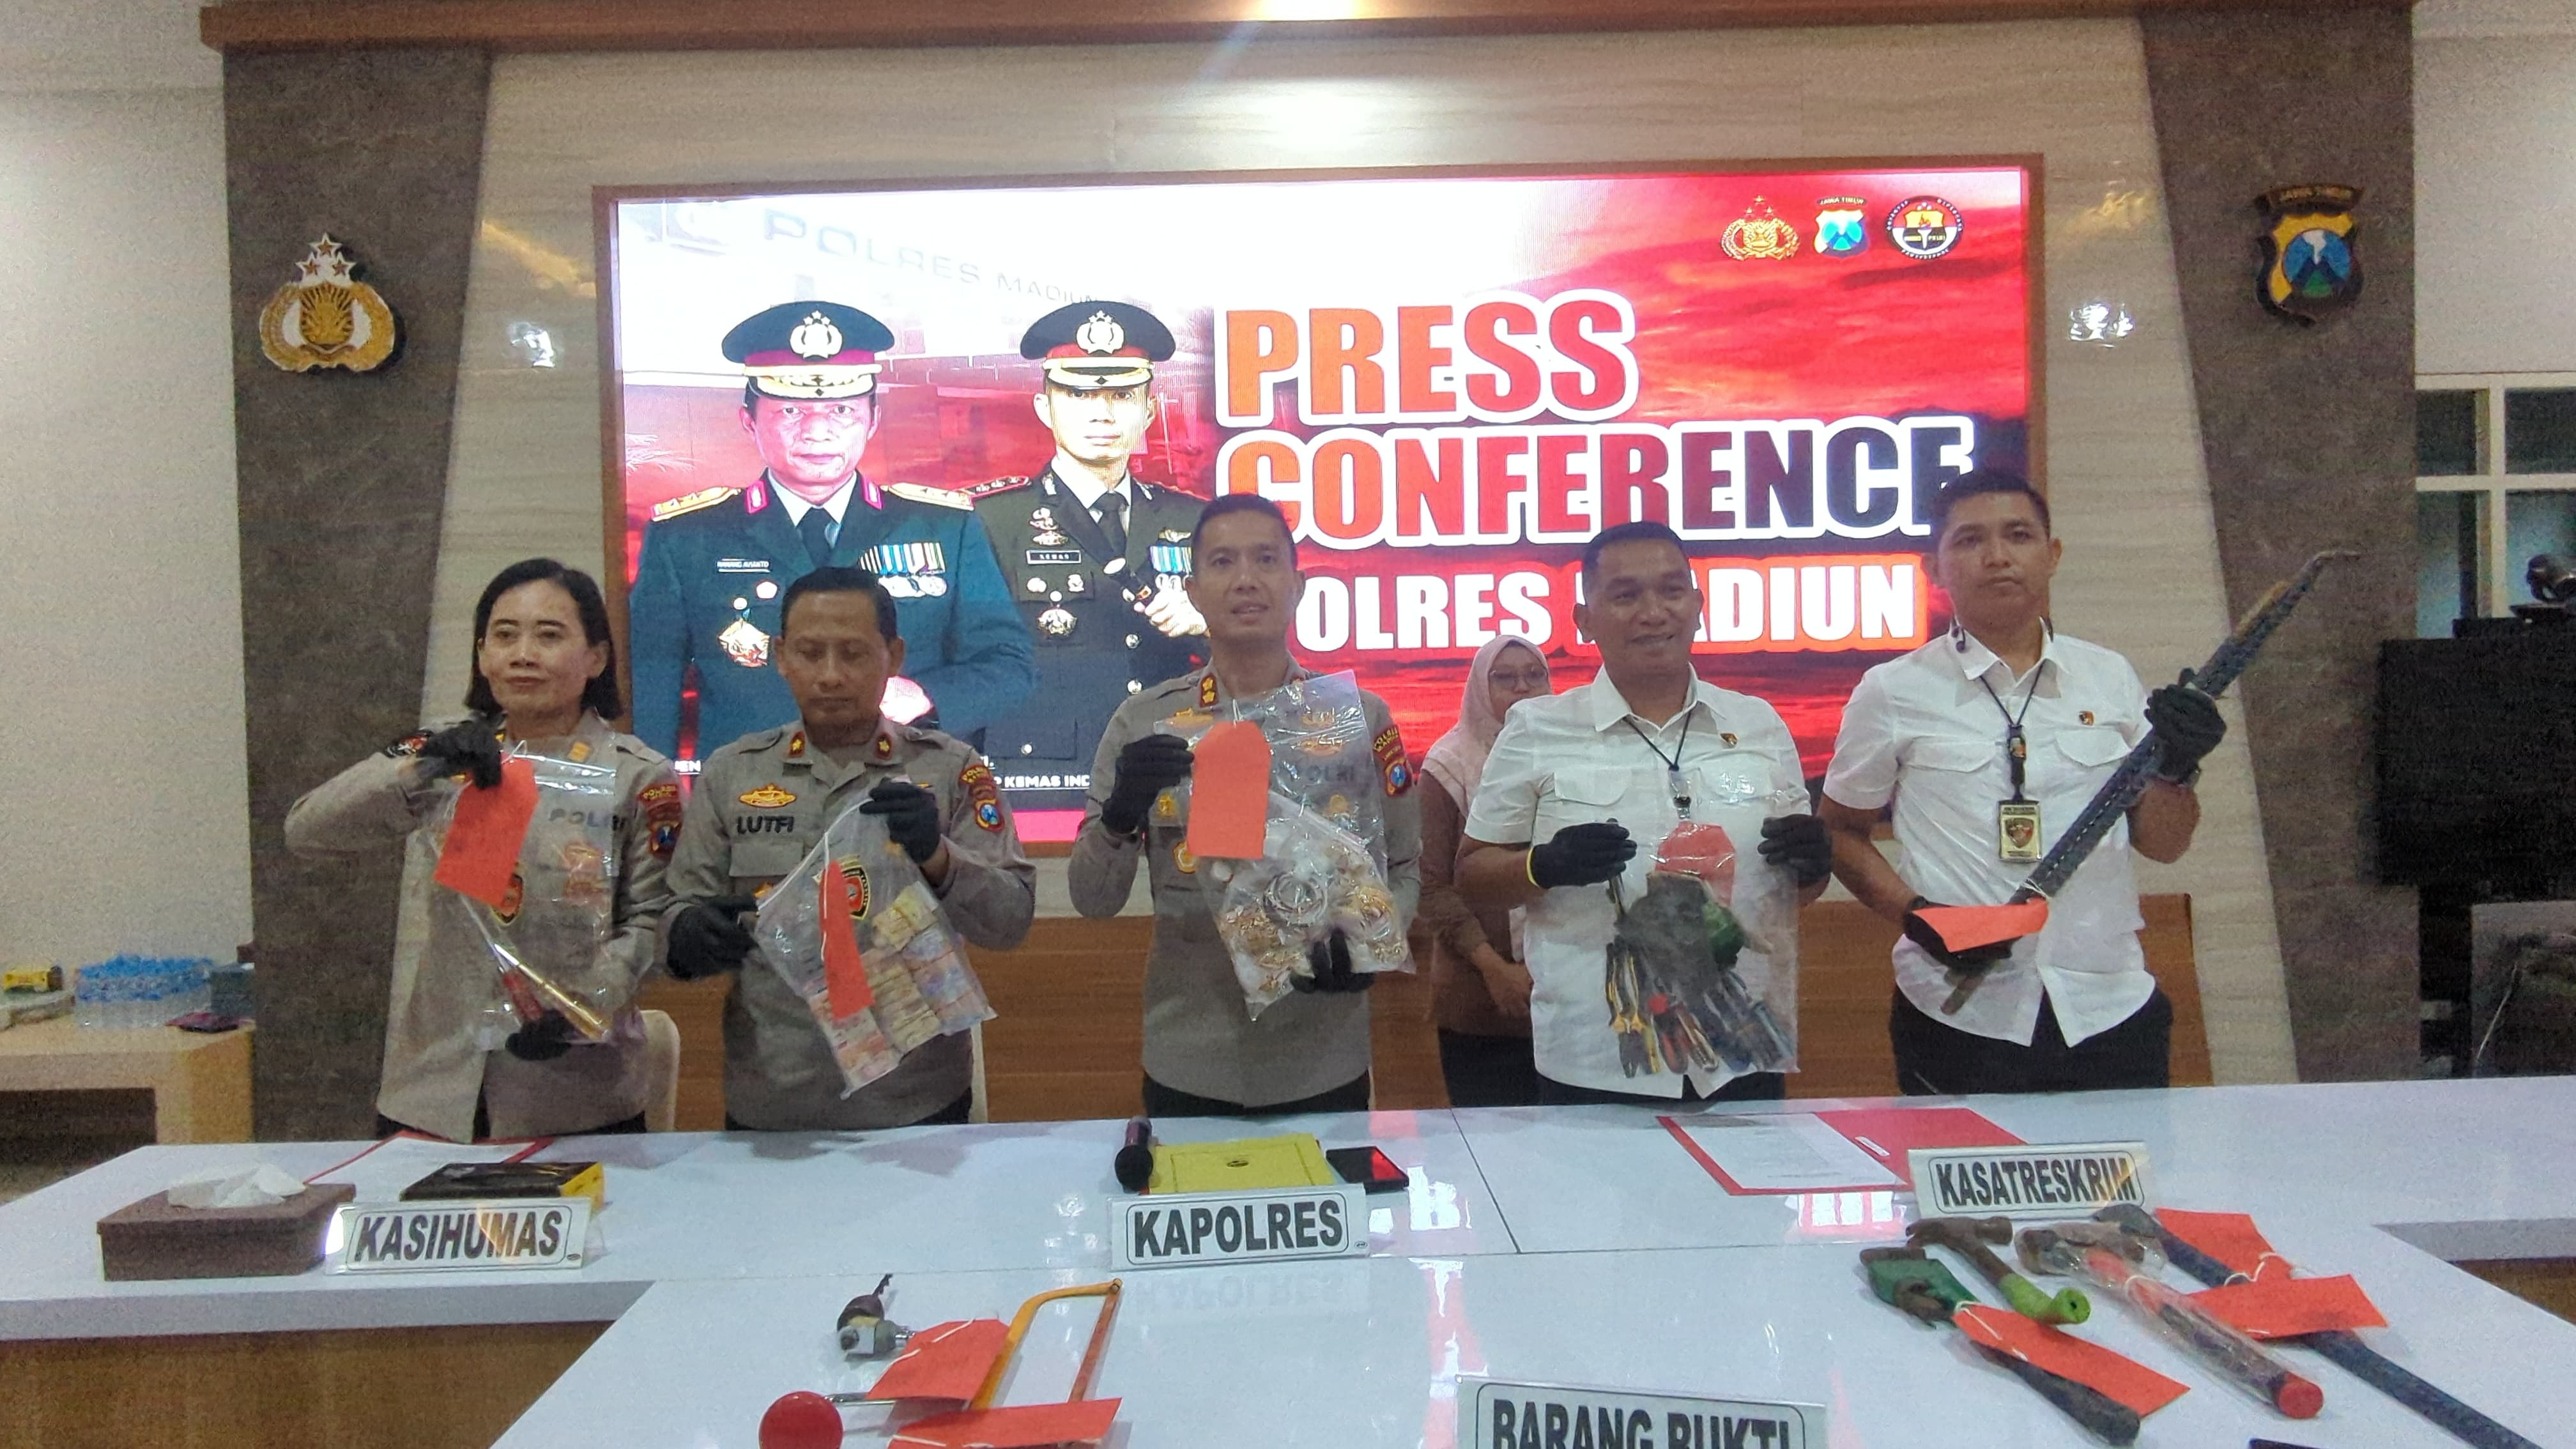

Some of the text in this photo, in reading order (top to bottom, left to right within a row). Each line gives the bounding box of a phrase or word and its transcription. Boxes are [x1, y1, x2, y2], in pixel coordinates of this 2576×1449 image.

[766, 209, 981, 285] POLRES
[1223, 298, 1629, 419] PRESS
[1225, 424, 1965, 543] CONFERENCE
[1296, 564, 1915, 652] OLRES DIUN
[1004, 775, 1061, 788] KEMAS
[737, 815, 794, 834] LUTFI
[1935, 1158, 2136, 1208] KASATRESKRIM
[354, 1209, 562, 1262] KASIHUMAS
[1134, 1199, 1343, 1257] KAPOLRES
[1492, 1399, 1790, 1449] BARANG BUKTI
